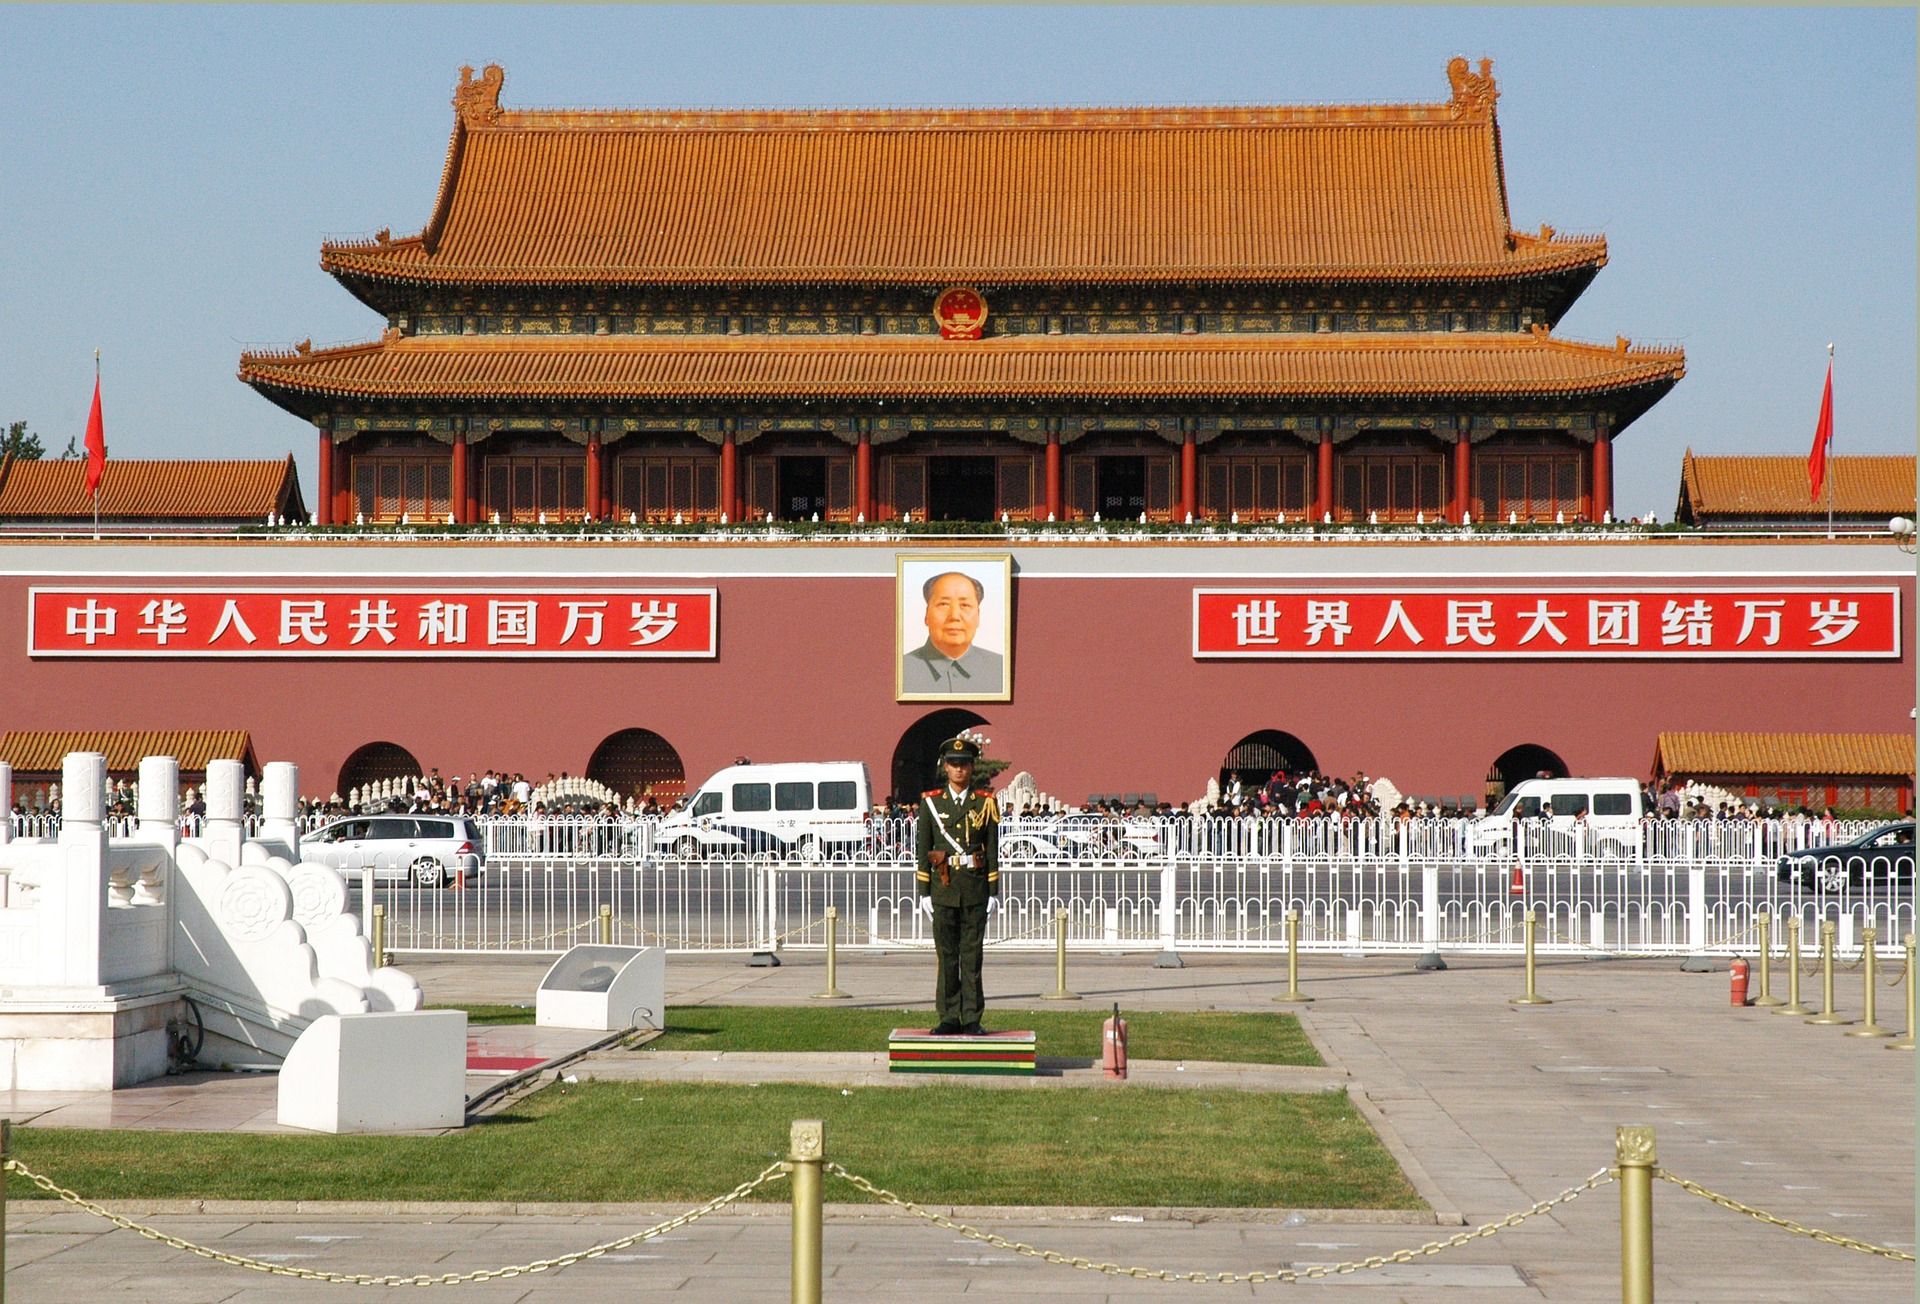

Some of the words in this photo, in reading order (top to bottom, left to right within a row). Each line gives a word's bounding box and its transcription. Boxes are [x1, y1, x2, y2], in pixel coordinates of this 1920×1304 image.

[66, 599, 679, 645] 中华人民共和国万岁
[1231, 600, 1860, 646] 世界人民大团结万岁
[776, 819, 796, 828] 公安
